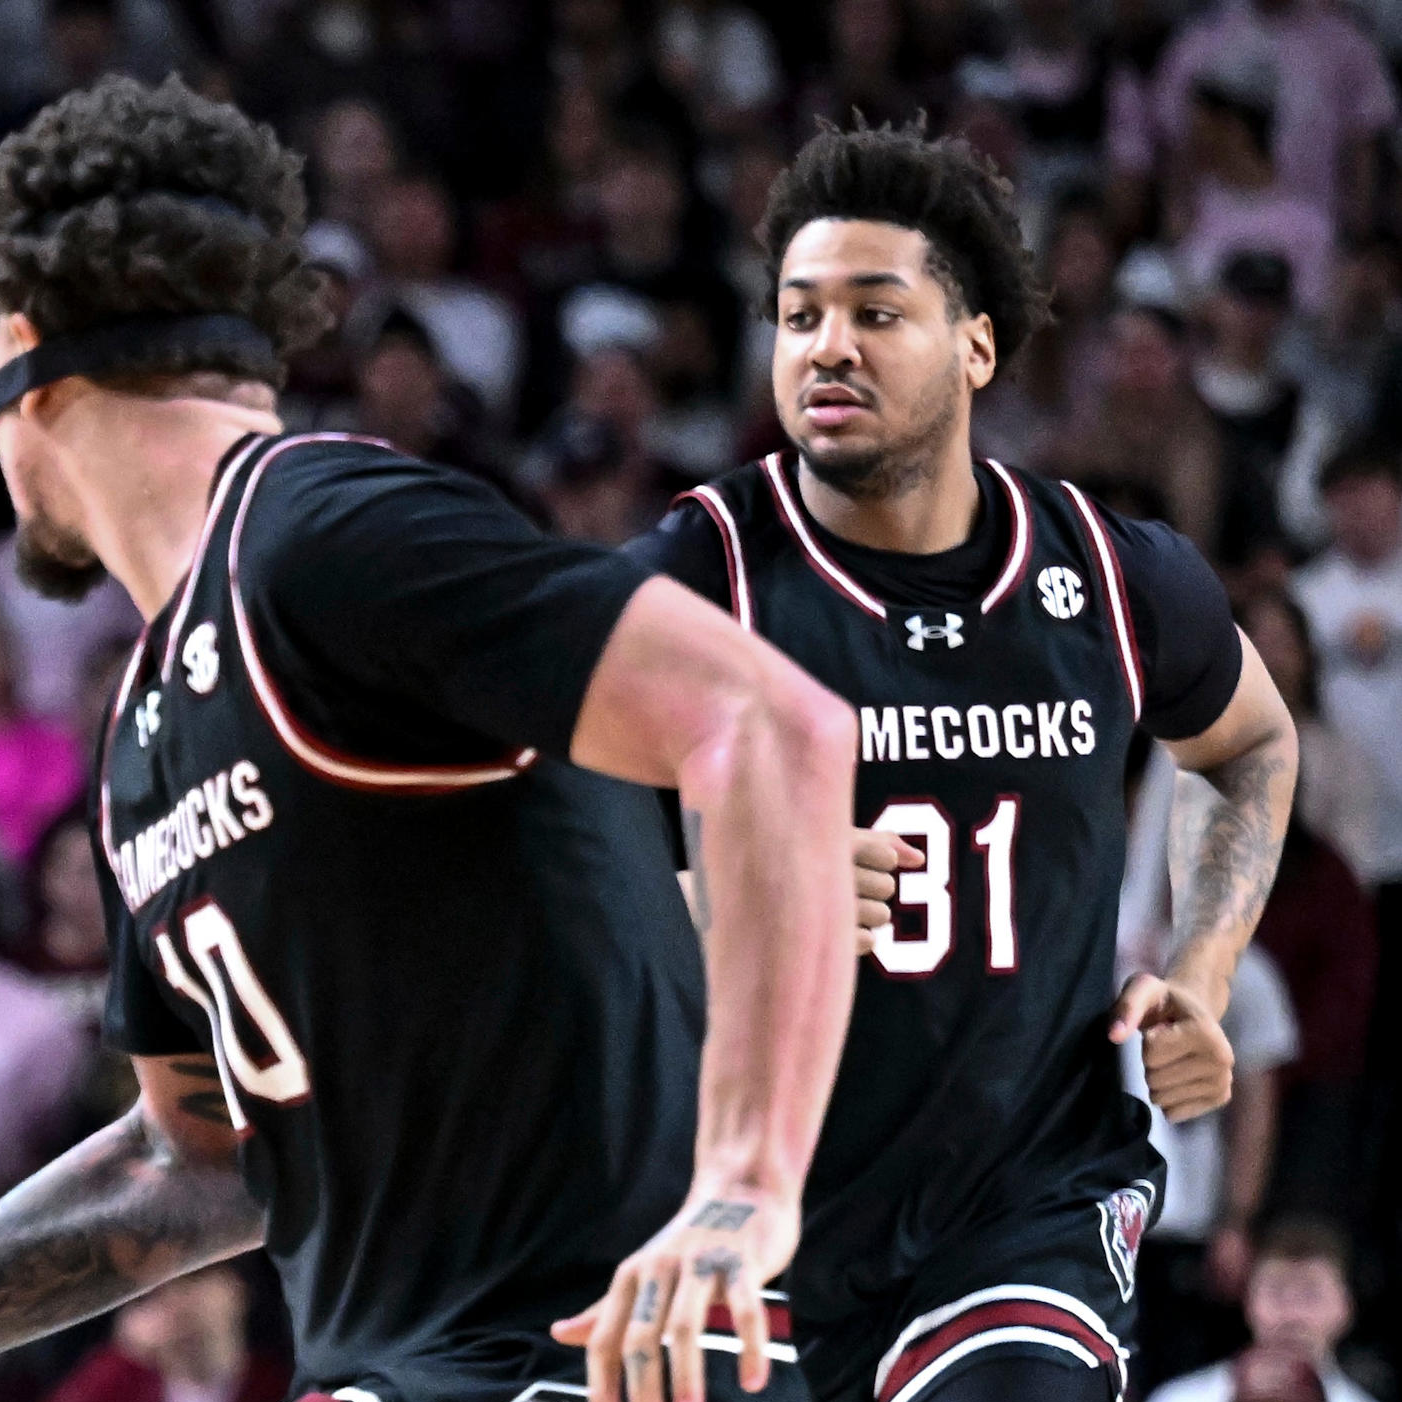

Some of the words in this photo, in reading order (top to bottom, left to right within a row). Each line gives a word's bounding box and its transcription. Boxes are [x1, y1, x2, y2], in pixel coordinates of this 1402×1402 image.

[1037, 566, 1084, 619] SEC
[862, 699, 1096, 761] MECOCKS
[870, 794, 1021, 976] 31
